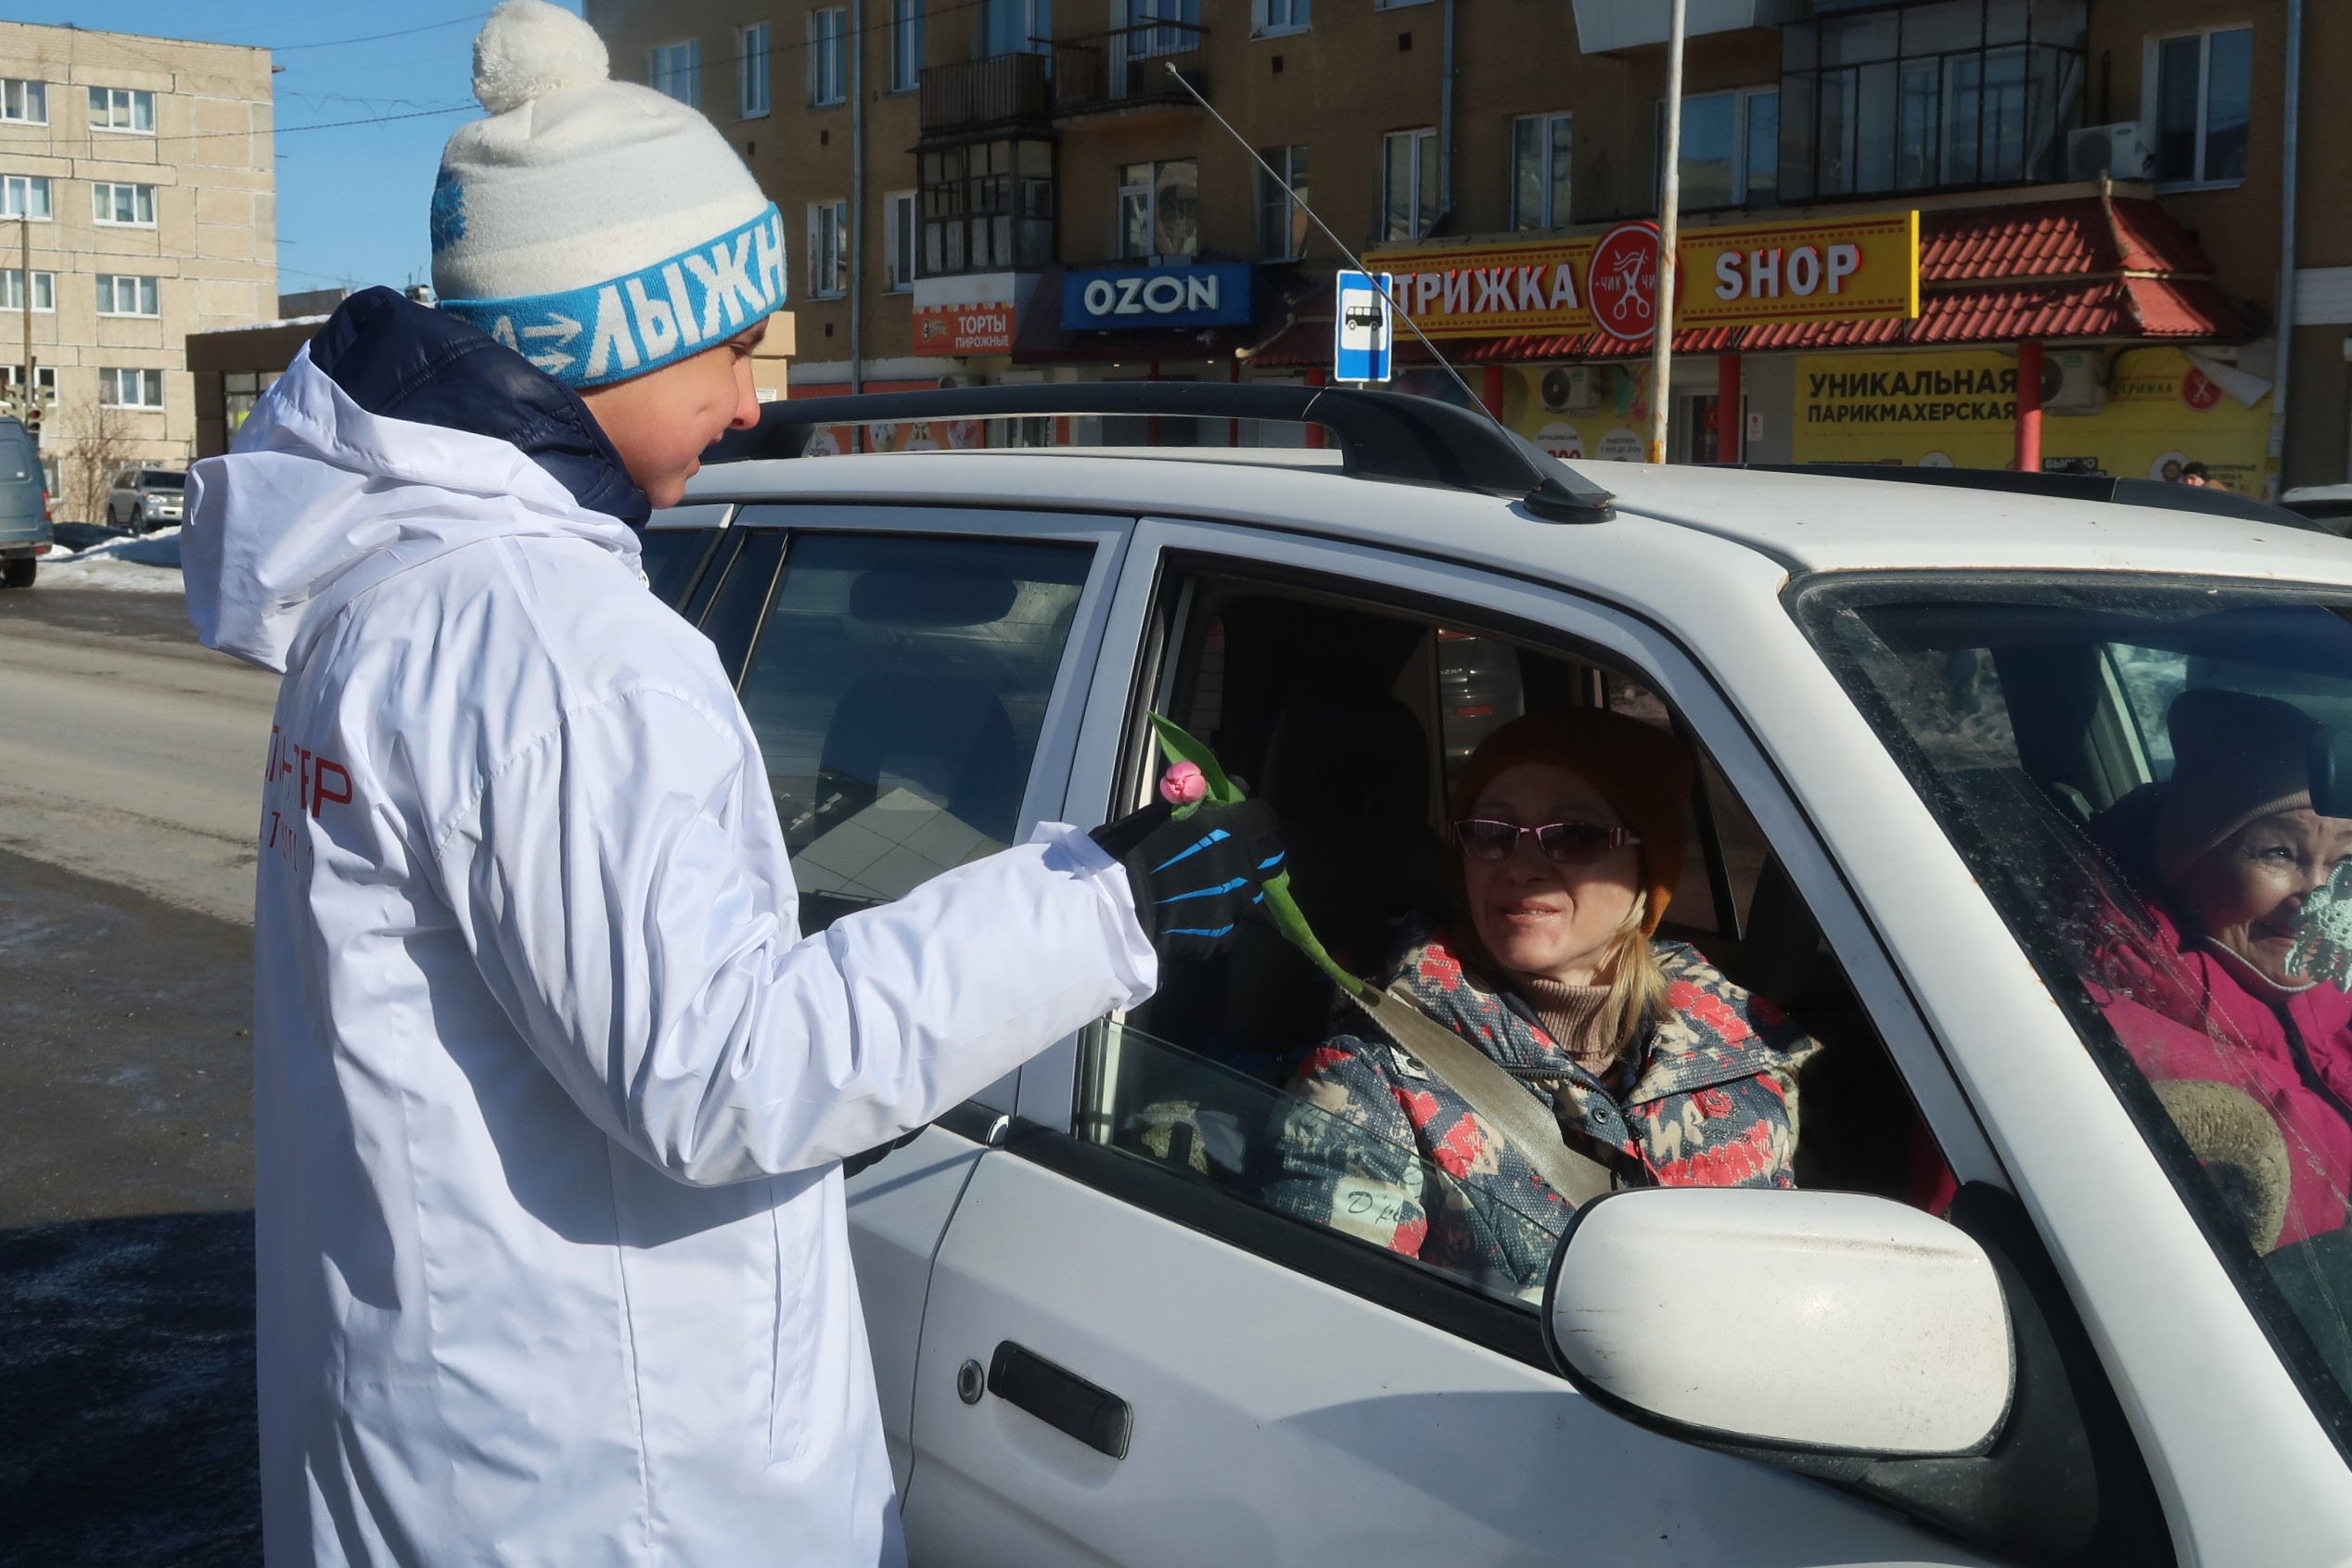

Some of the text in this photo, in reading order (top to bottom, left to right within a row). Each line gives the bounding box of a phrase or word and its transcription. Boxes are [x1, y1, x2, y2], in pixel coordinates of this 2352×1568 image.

[1642, 274, 1657, 289] ЧИ
[1714, 243, 1860, 300] SHOP
[584, 213, 786, 379] ЛЫЖН
[1083, 274, 1220, 316] OZON
[1394, 263, 1579, 316] ТРИЖКА
[958, 314, 1006, 335] ТОРТЫ
[955, 335, 1009, 350] ПИРОЖНЫЕ
[1809, 368, 2019, 398] УНИКАЛЬНАЯ
[1808, 401, 2018, 423] ПАРИКМАХЕРСКАЯ
